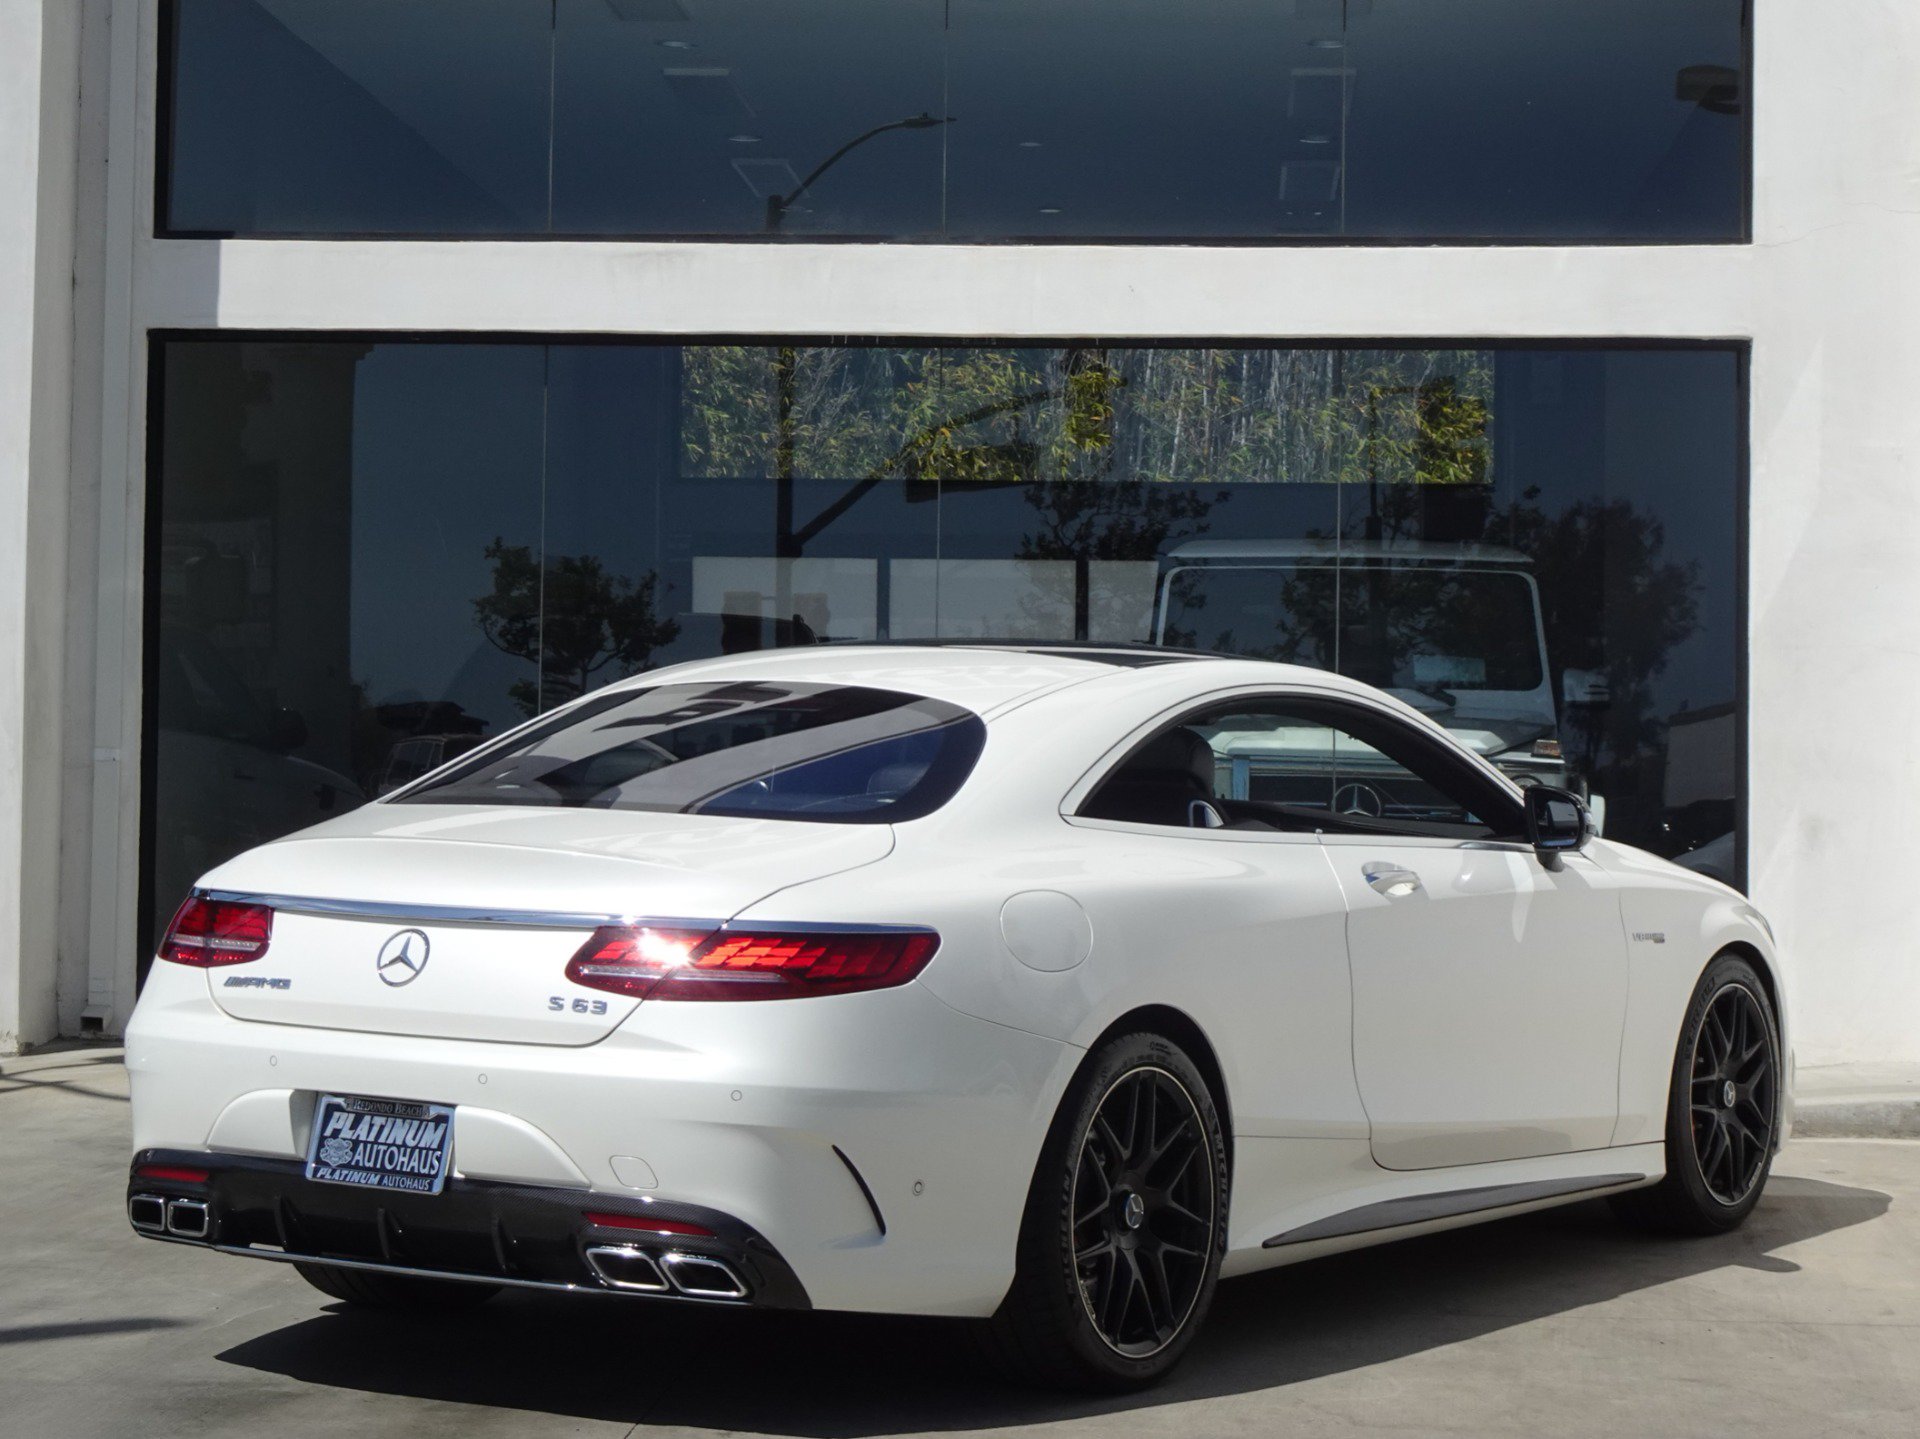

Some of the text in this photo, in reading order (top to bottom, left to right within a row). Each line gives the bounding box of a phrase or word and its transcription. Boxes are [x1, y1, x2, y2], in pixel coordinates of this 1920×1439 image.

[548, 996, 608, 1015] S 63
[353, 1099, 423, 1116] REDONDO BEACH
[323, 1111, 447, 1149] PLATINUM
[351, 1143, 442, 1175] AUTOHAUS
[316, 1167, 430, 1191] PLATINUM AUTOHAUS
